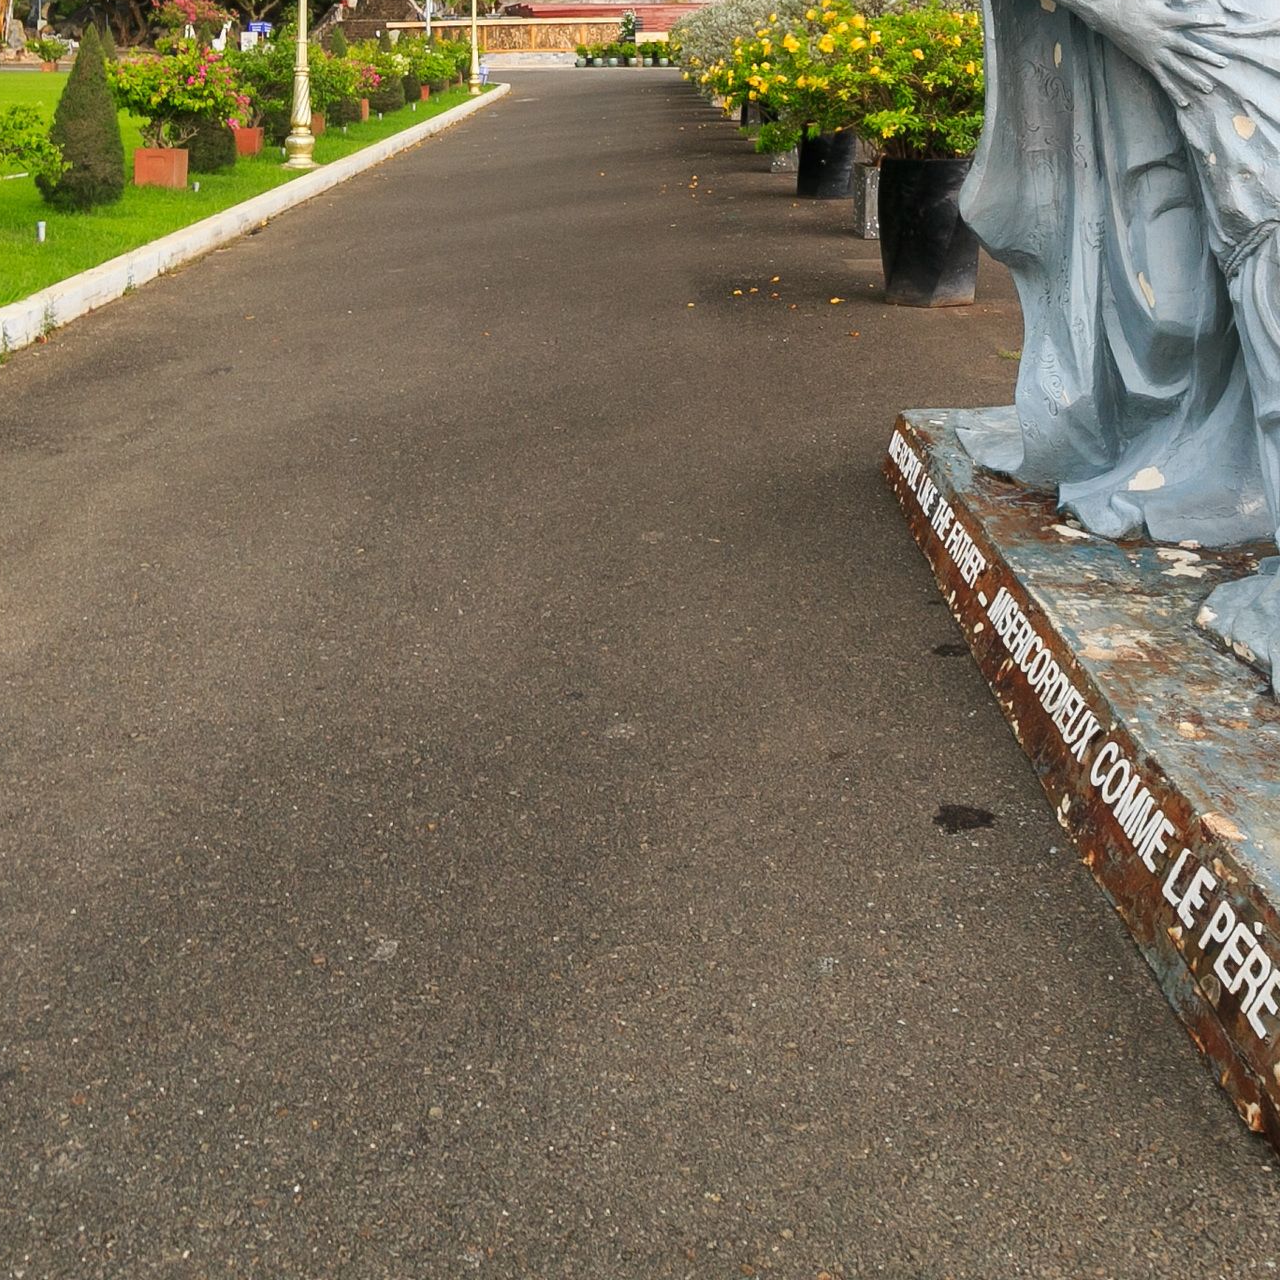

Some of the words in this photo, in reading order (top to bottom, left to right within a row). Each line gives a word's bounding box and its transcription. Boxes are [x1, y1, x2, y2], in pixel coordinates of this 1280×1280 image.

[916, 473, 938, 517] LIKE
[931, 496, 955, 541] THE
[944, 520, 987, 589] FATHER
[987, 586, 1101, 762] MISERICORDIEUX
[1090, 741, 1175, 873] COMME
[1162, 847, 1217, 929] LE
